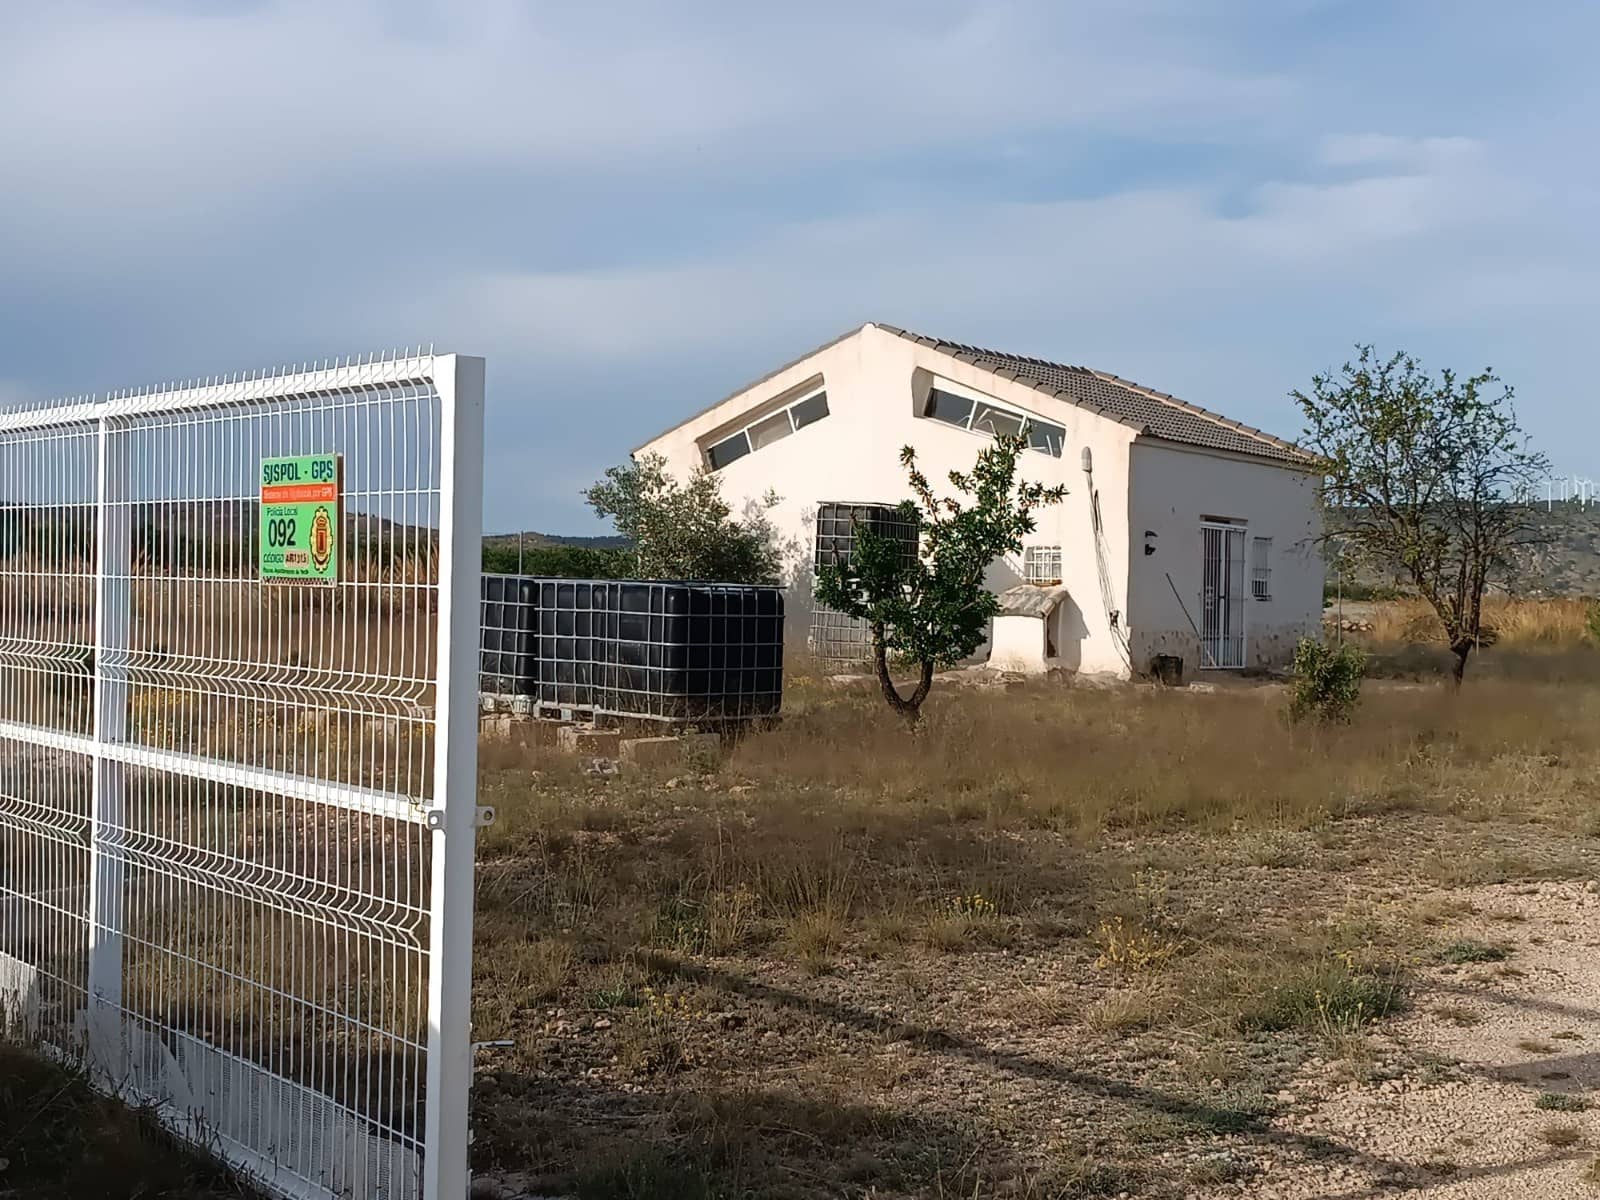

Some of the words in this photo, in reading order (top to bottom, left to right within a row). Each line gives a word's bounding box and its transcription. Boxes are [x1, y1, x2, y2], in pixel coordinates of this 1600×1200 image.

[263, 462, 301, 482] SISPOL
[311, 460, 333, 479] GPS
[268, 518, 296, 547] 092
